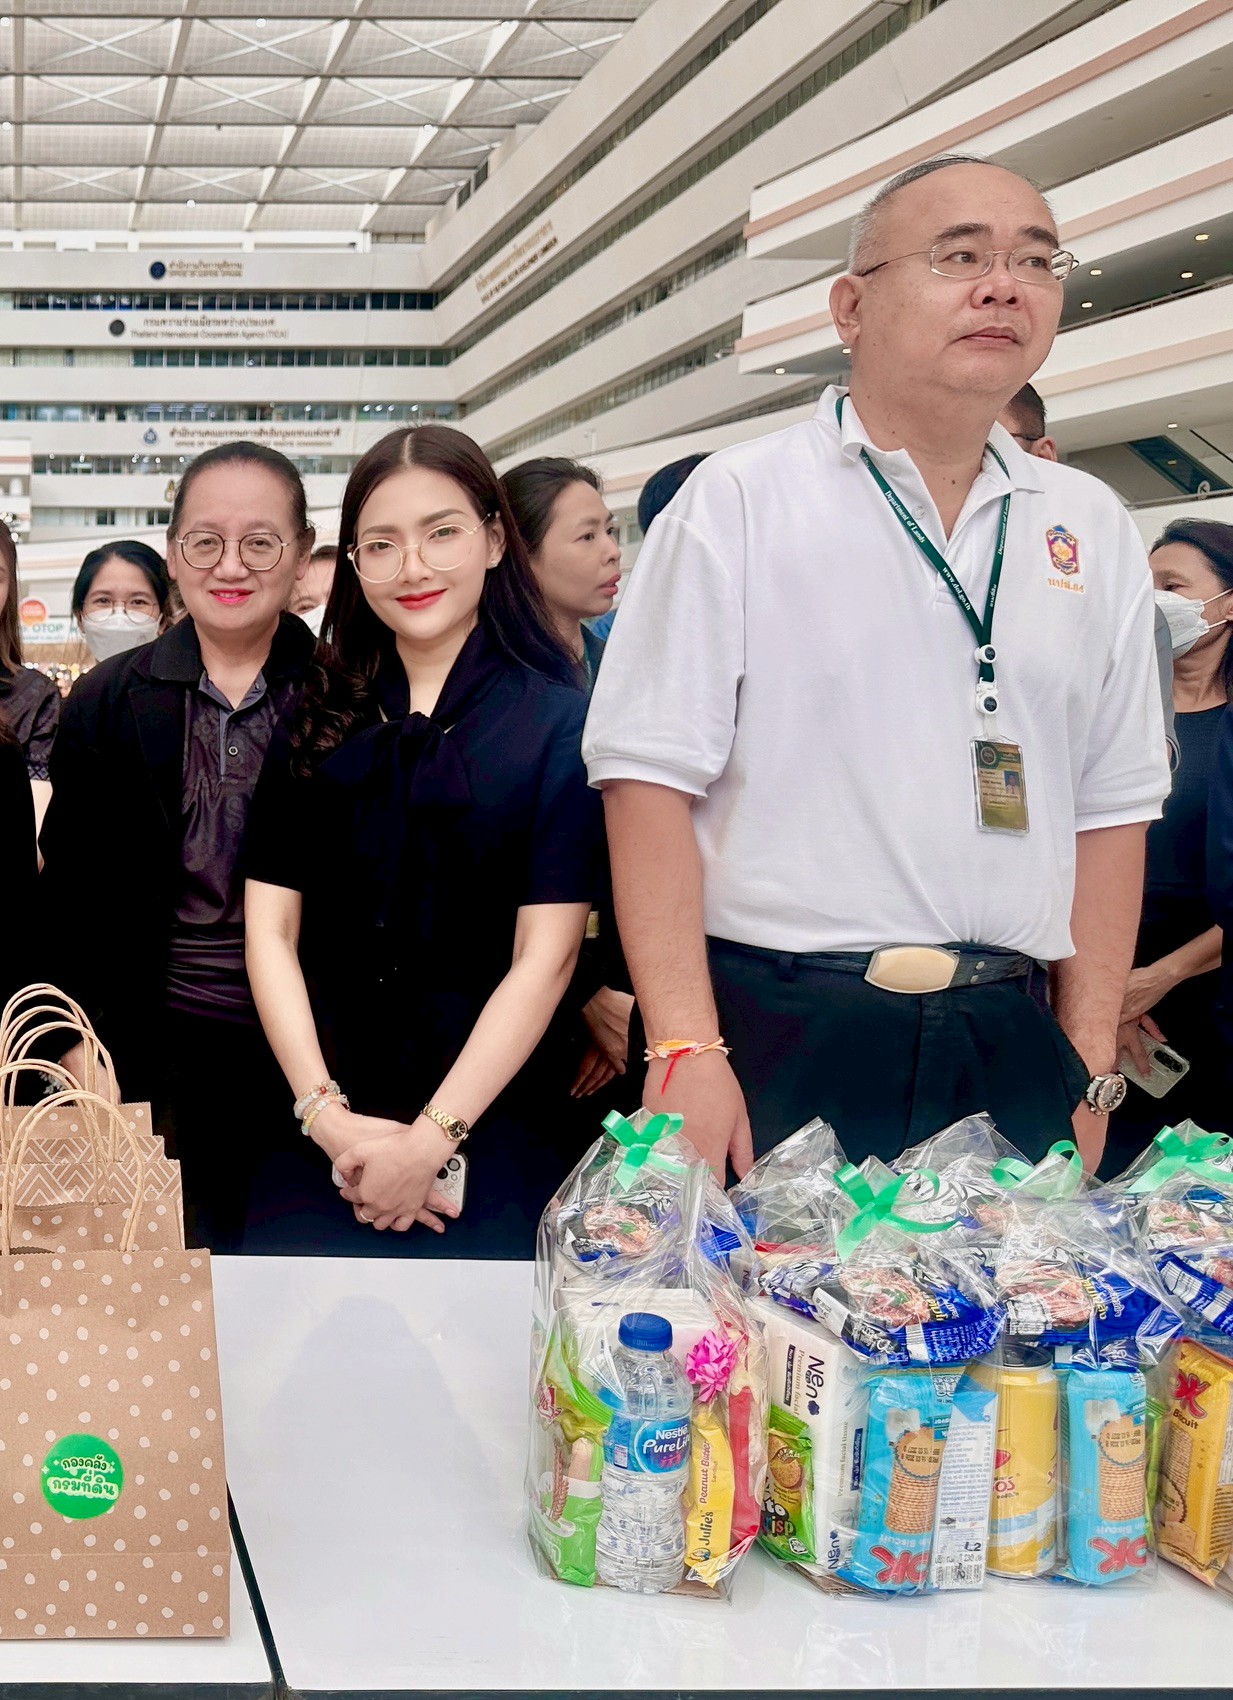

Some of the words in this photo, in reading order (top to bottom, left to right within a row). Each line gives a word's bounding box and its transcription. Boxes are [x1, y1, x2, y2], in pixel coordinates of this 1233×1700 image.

[884, 490, 909, 524] Department
[910, 526, 926, 544] Lands
[942, 566, 971, 611] www.dol.go.th
[32, 623, 64, 633] OTOP
[795, 1349, 805, 1390] Premium
[806, 1355, 825, 1399] Nen
[793, 1391, 802, 1416] facial
[841, 1421, 849, 1442] tissue
[62, 1455, 107, 1471] กองคลัง
[701, 1441, 711, 1467] Butter
[839, 1443, 847, 1463] facial
[53, 1469, 115, 1495] กรมที่ดิน
[699, 1468, 709, 1504] Peanut
[837, 1463, 846, 1497] Premium
[698, 1511, 714, 1546] Julie's
[826, 1539, 840, 1569] Nen
